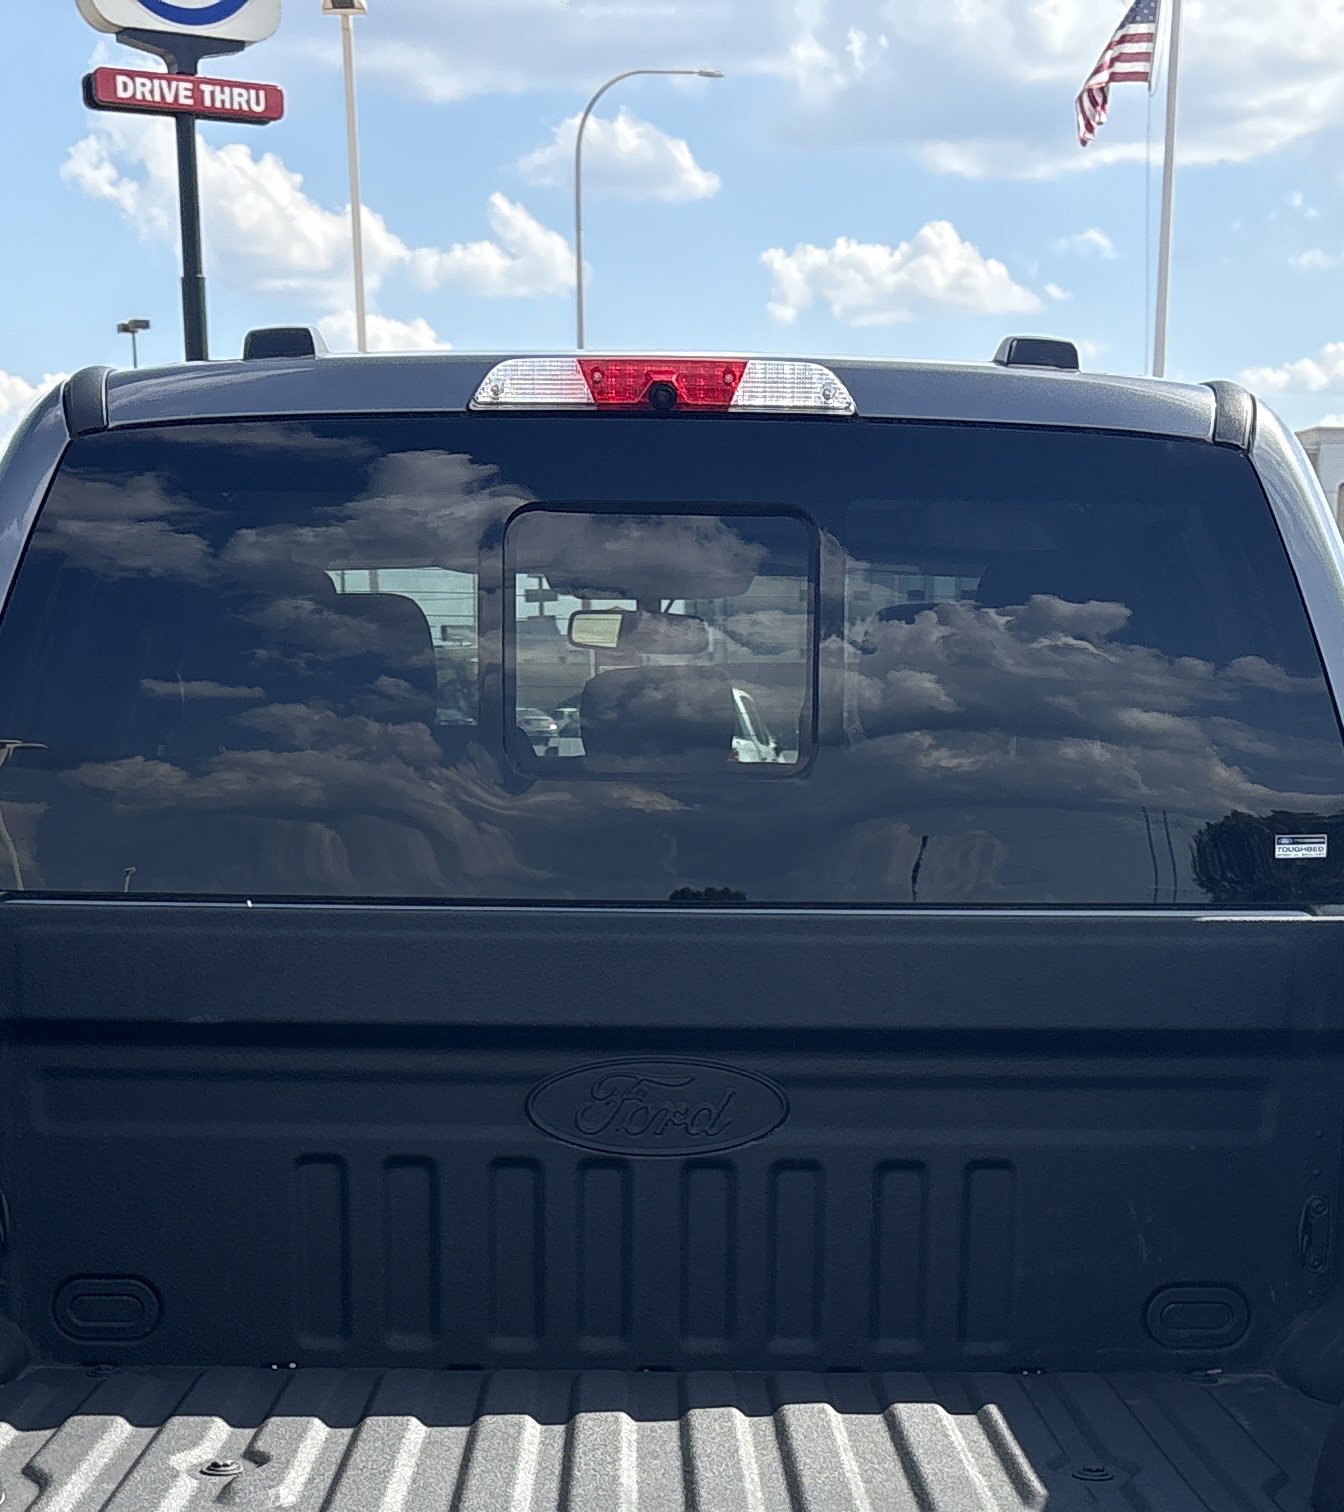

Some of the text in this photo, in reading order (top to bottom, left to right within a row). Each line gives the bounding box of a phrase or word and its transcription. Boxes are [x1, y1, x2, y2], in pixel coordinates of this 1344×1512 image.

[114, 75, 266, 113] DRIVE THRU
[574, 1069, 737, 1137] Ford
